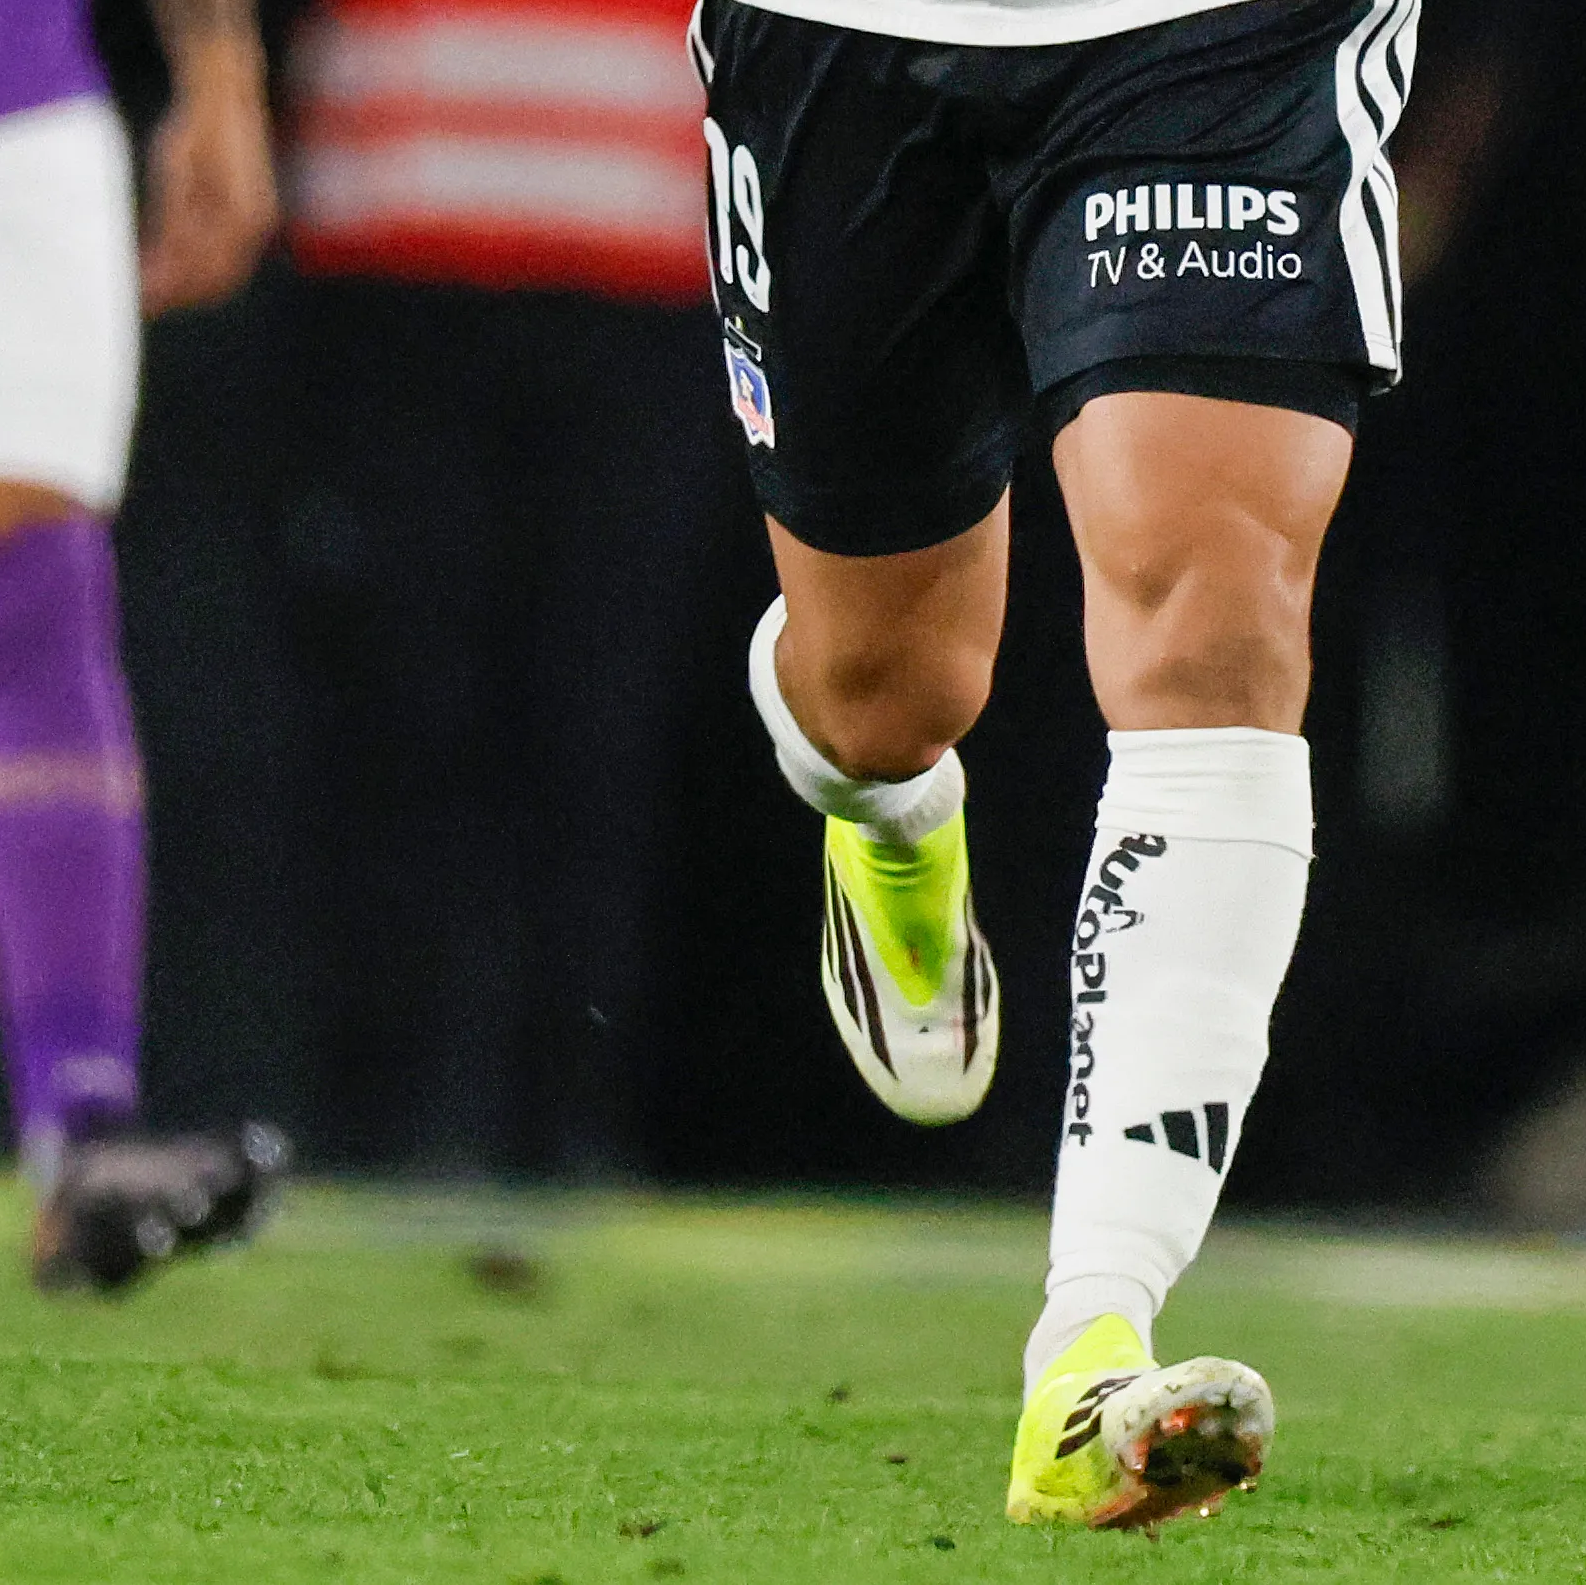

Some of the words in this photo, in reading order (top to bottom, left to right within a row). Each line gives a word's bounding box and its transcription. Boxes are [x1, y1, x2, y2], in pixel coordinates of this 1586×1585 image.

[703, 117, 771, 313] 19
[1085, 183, 1301, 242] PHILIPS
[1087, 246, 1127, 288] TV
[1136, 243, 1165, 280] &
[1176, 240, 1302, 280] Audio
